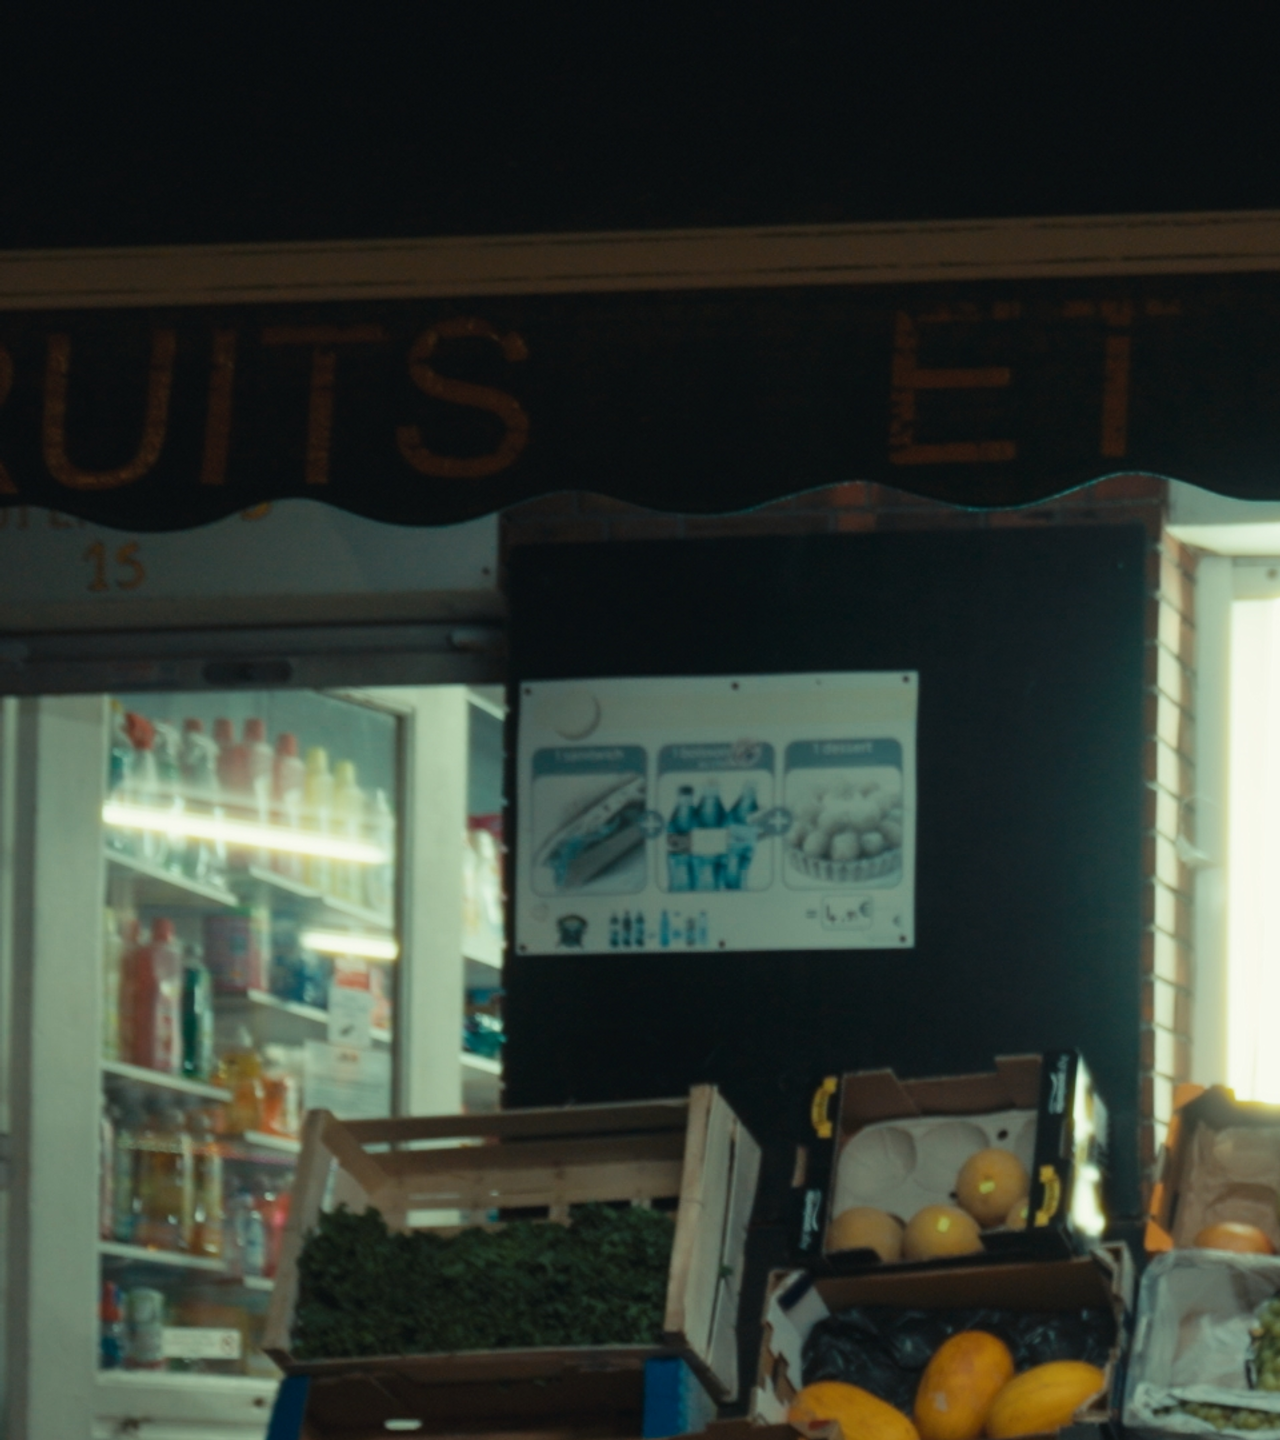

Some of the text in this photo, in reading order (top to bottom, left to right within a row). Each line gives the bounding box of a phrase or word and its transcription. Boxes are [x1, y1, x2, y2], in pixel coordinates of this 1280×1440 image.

[0, 314, 530, 496] UITS
[888, 296, 1184, 466] ET
[84, 540, 146, 592] 15
